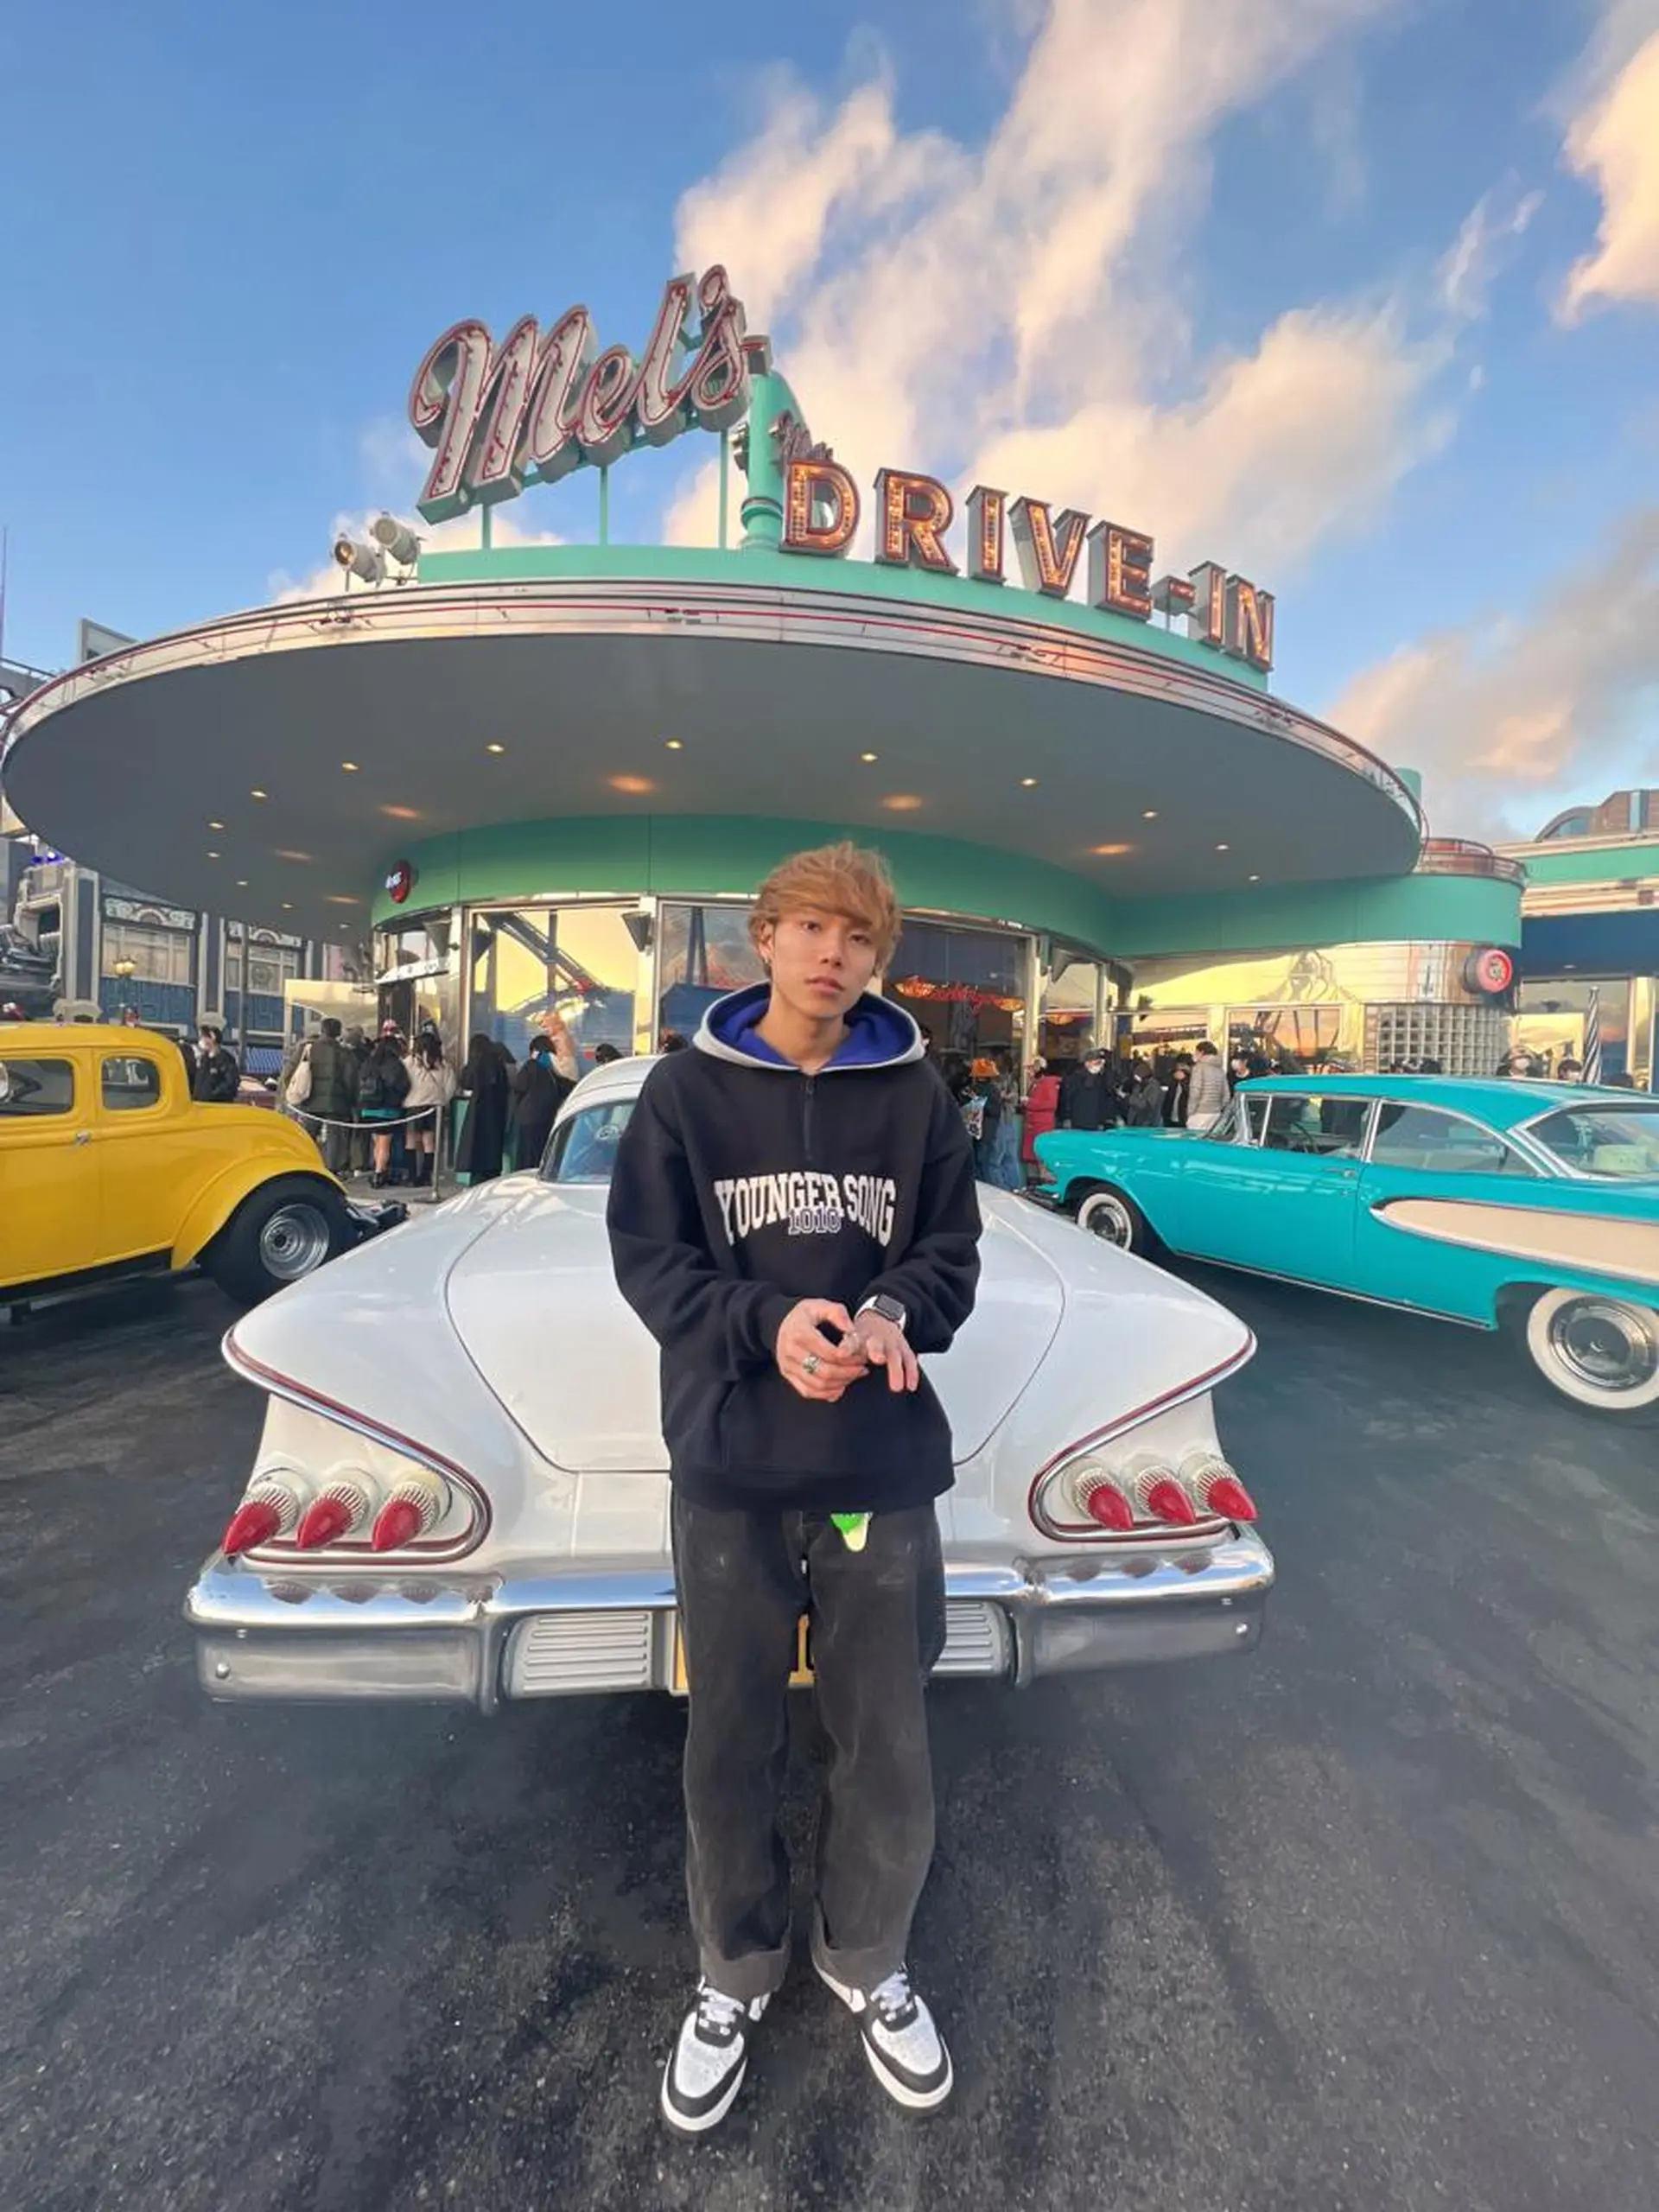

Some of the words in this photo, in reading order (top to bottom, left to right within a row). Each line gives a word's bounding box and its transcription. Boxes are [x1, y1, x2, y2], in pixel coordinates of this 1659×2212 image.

[410, 264, 750, 517] Mel's
[783, 457, 1274, 672] DRIVE-IN
[714, 1172, 844, 1246] YOUNGER
[842, 1174, 896, 1247] SONG
